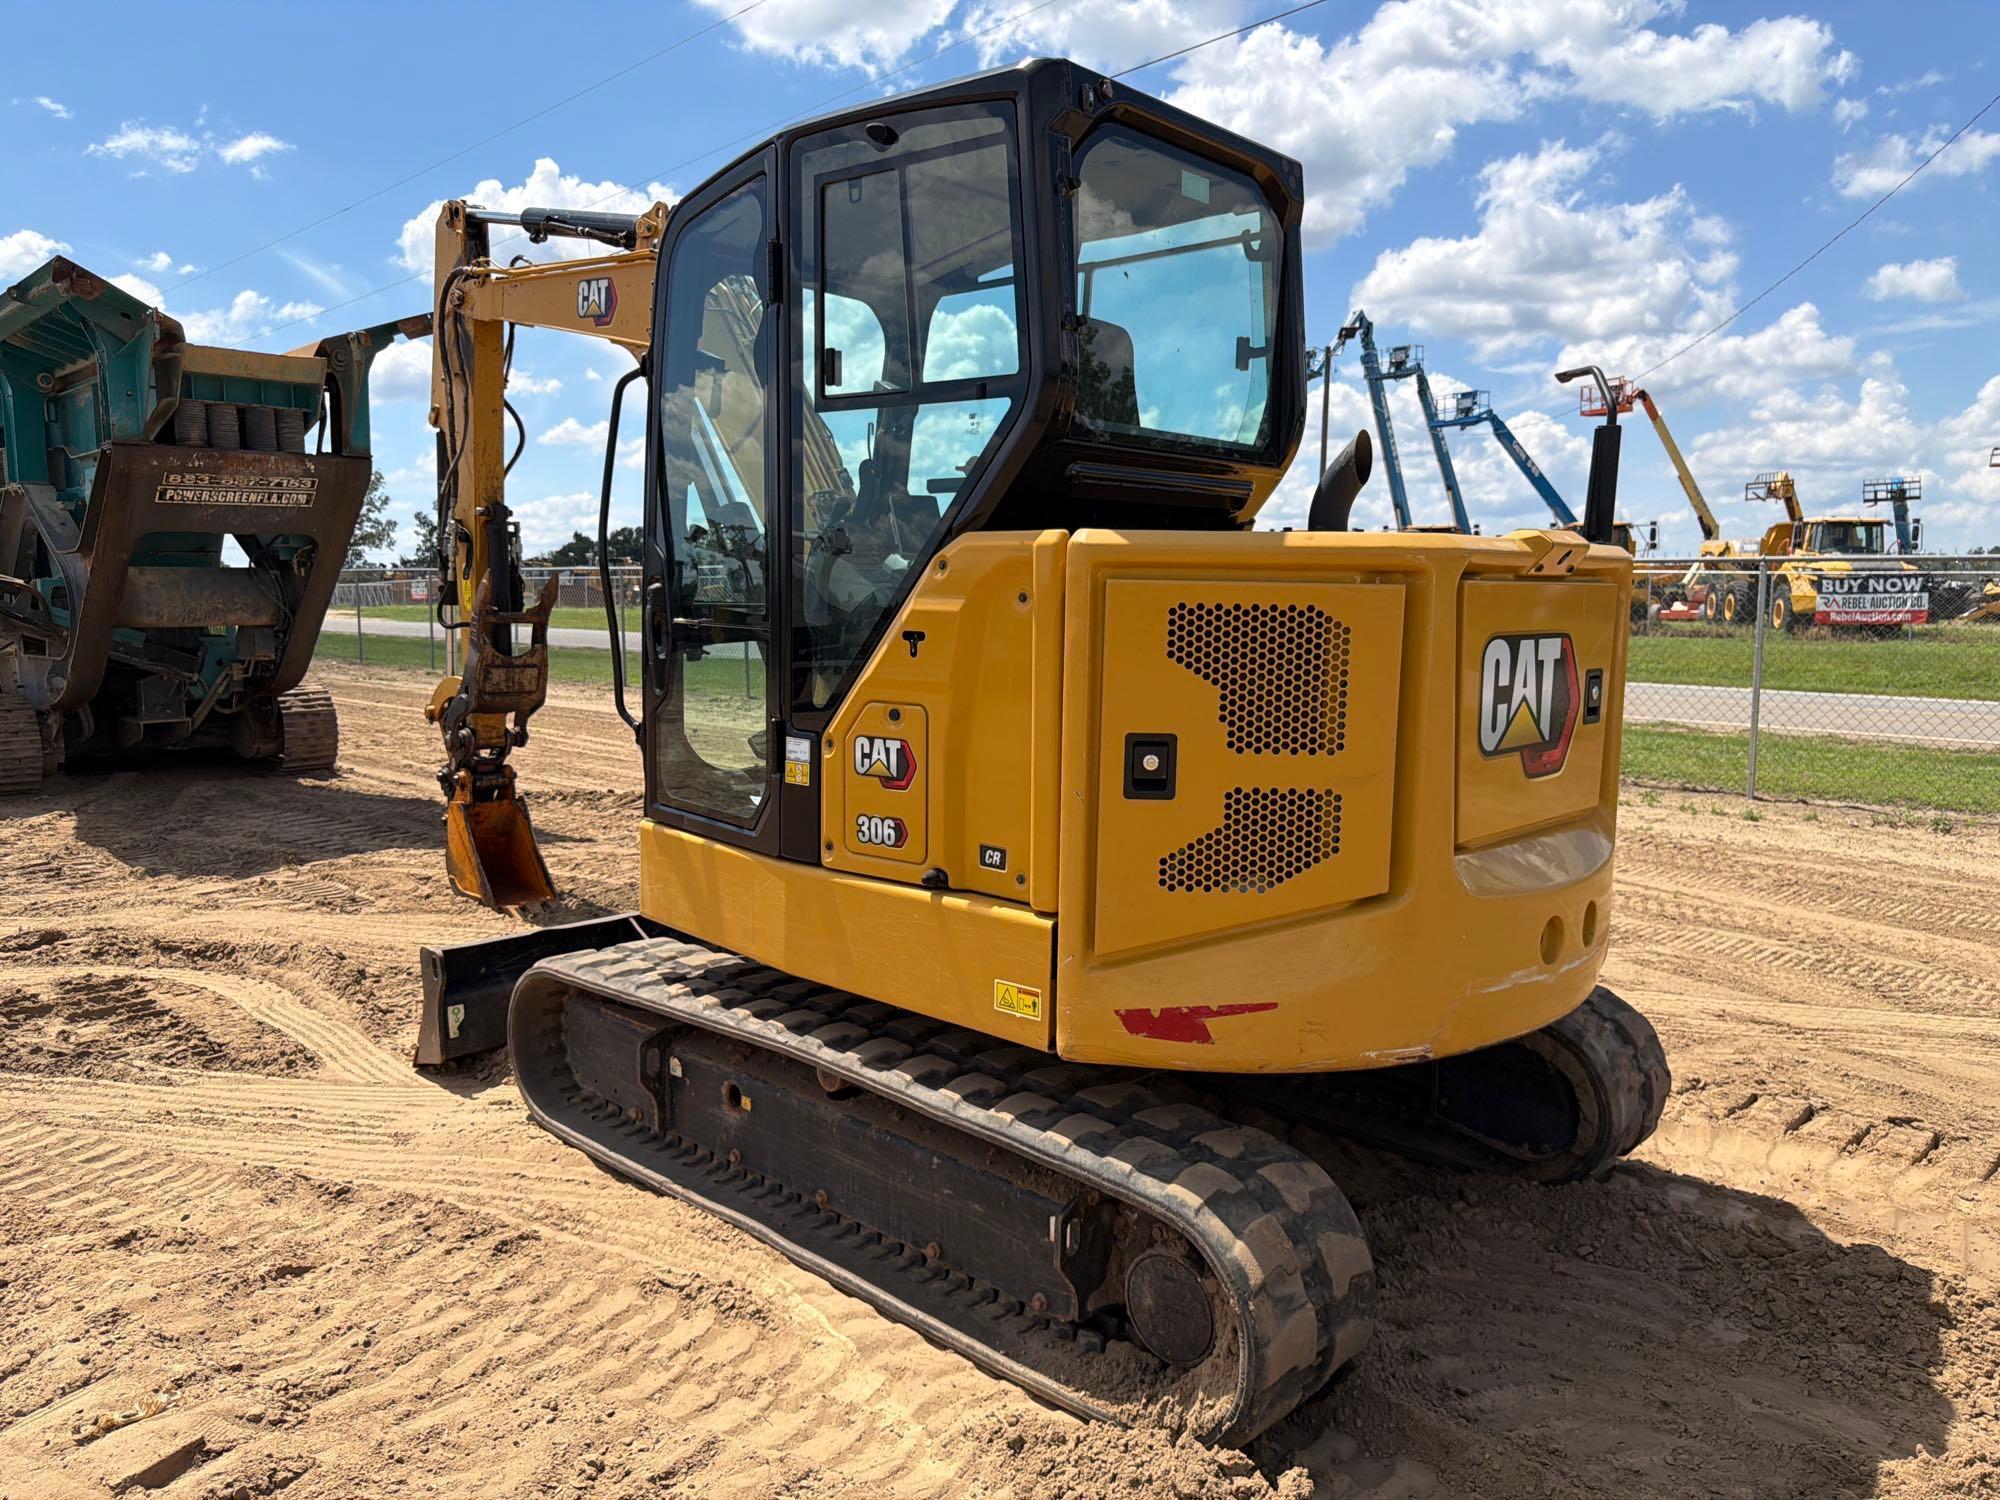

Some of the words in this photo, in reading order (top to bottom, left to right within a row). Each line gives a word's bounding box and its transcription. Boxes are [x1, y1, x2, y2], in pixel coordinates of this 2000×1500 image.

[578, 279, 609, 316] CAT
[165, 490, 307, 504] POWERSCREENFLA.COM
[1822, 578, 1864, 593] BUY
[1868, 577, 1923, 592] NOW
[1842, 597, 1867, 609] REBEL
[1870, 597, 1907, 609] AUCTION
[1911, 596, 1925, 608] CO.
[1830, 612, 1911, 622] RebelAuction.com
[1480, 638, 1562, 752] CAT
[855, 736, 901, 778] CAT
[857, 815, 896, 847] 306
[985, 849, 1001, 866] CR
